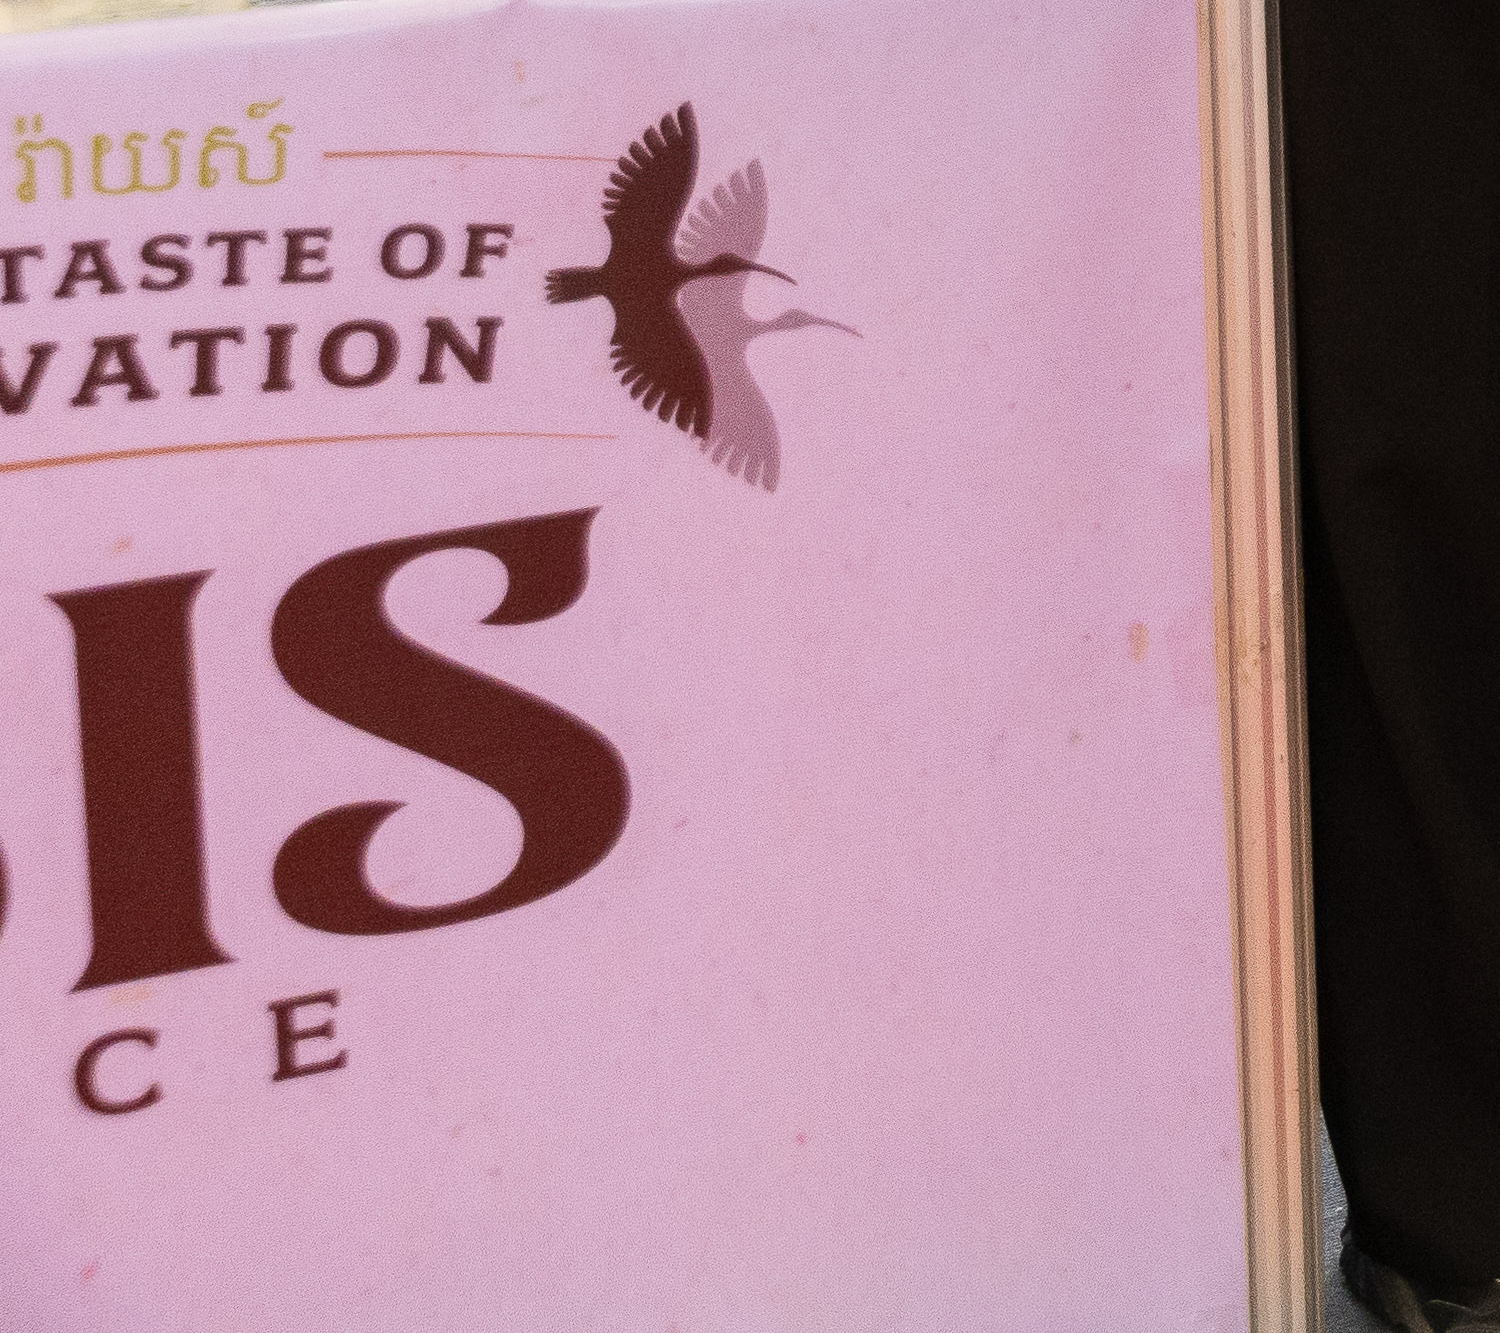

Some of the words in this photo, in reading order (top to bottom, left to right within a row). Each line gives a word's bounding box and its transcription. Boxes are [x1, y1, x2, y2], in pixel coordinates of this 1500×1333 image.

[0, 225, 335, 305] TASTE
[377, 222, 516, 283] OF
[0, 315, 507, 417] VATION
[0, 504, 634, 995] IS
[70, 988, 351, 1118] CE
